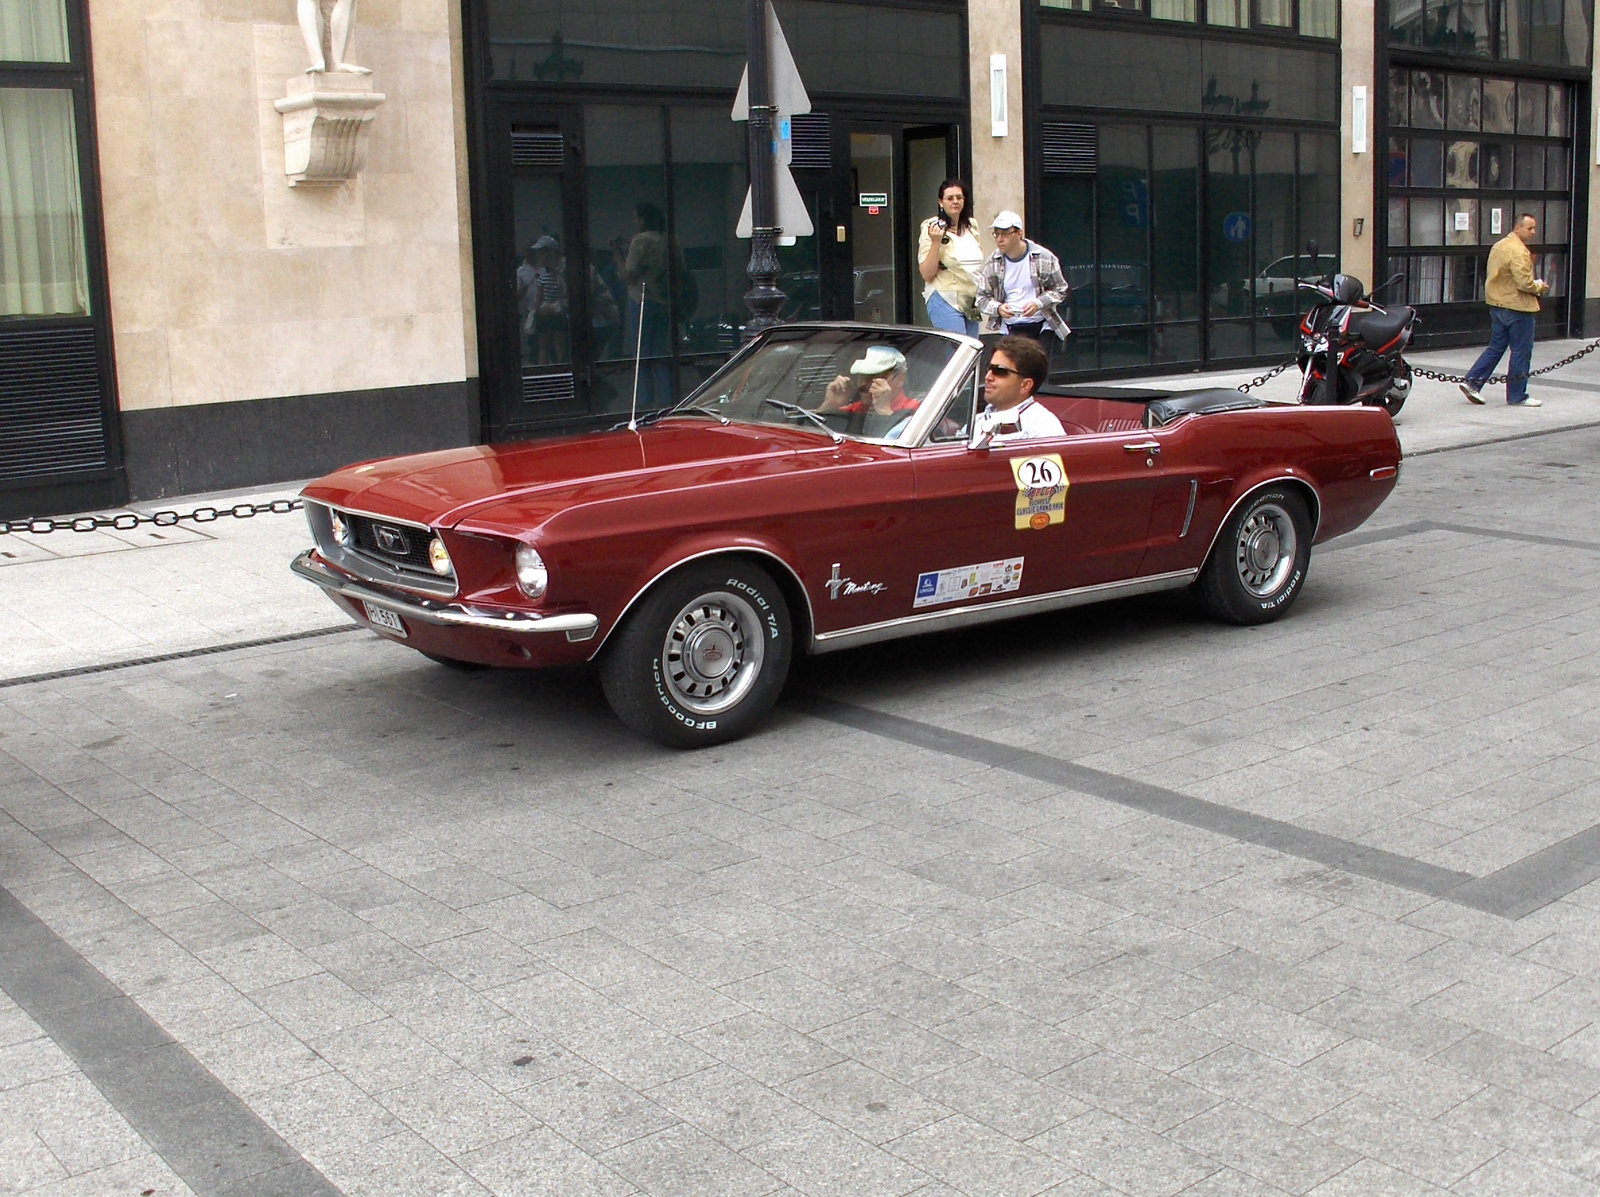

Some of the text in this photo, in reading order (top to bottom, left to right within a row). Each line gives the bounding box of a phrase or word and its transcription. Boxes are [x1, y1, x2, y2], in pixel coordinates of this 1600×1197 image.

[1026, 461, 1052, 484] 26
[842, 581, 888, 595] Mustang
[1261, 570, 1301, 610] Radial T/A
[726, 578, 779, 639] Radial T/A
[653, 658, 717, 730] BFGoodrich
